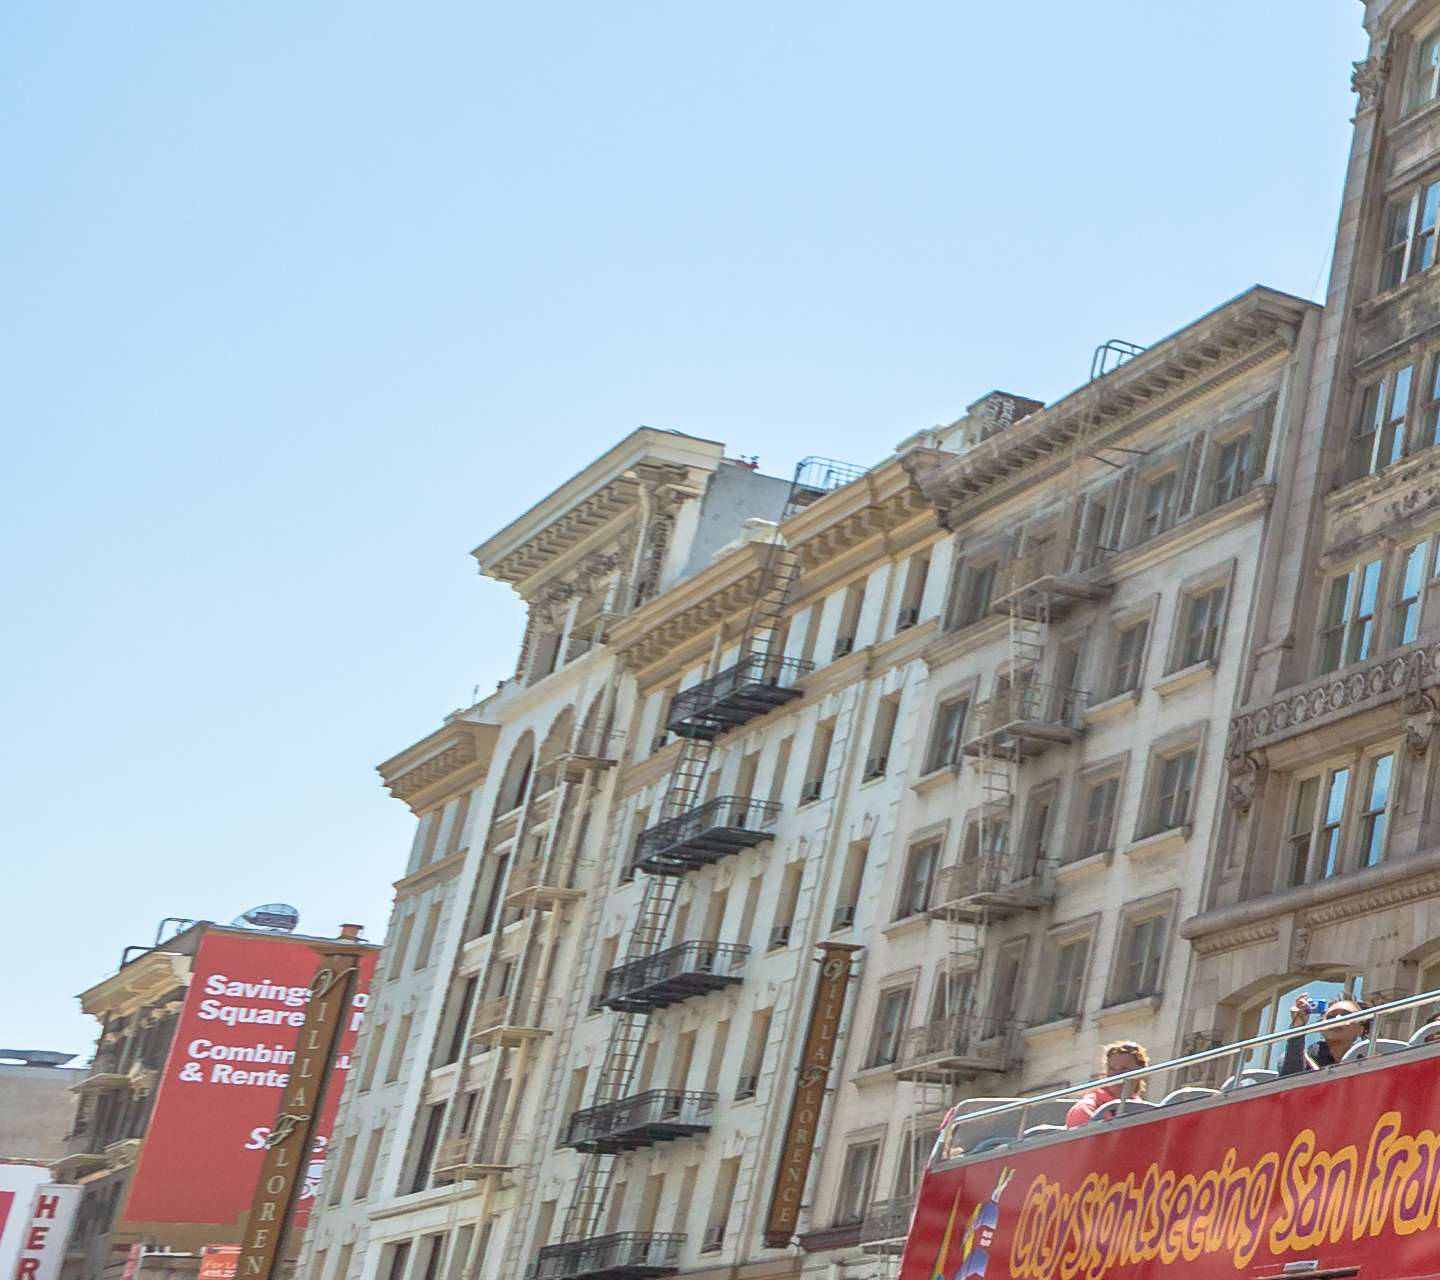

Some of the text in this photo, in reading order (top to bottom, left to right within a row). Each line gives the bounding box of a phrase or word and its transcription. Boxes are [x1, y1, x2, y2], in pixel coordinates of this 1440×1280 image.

[179, 1062, 204, 1082] &
[197, 999, 306, 1027] Square
[288, 967, 357, 1107] VILLA
[780, 957, 851, 1224] VILLA FLORENCE
[1269, 1127, 1360, 1255] San
